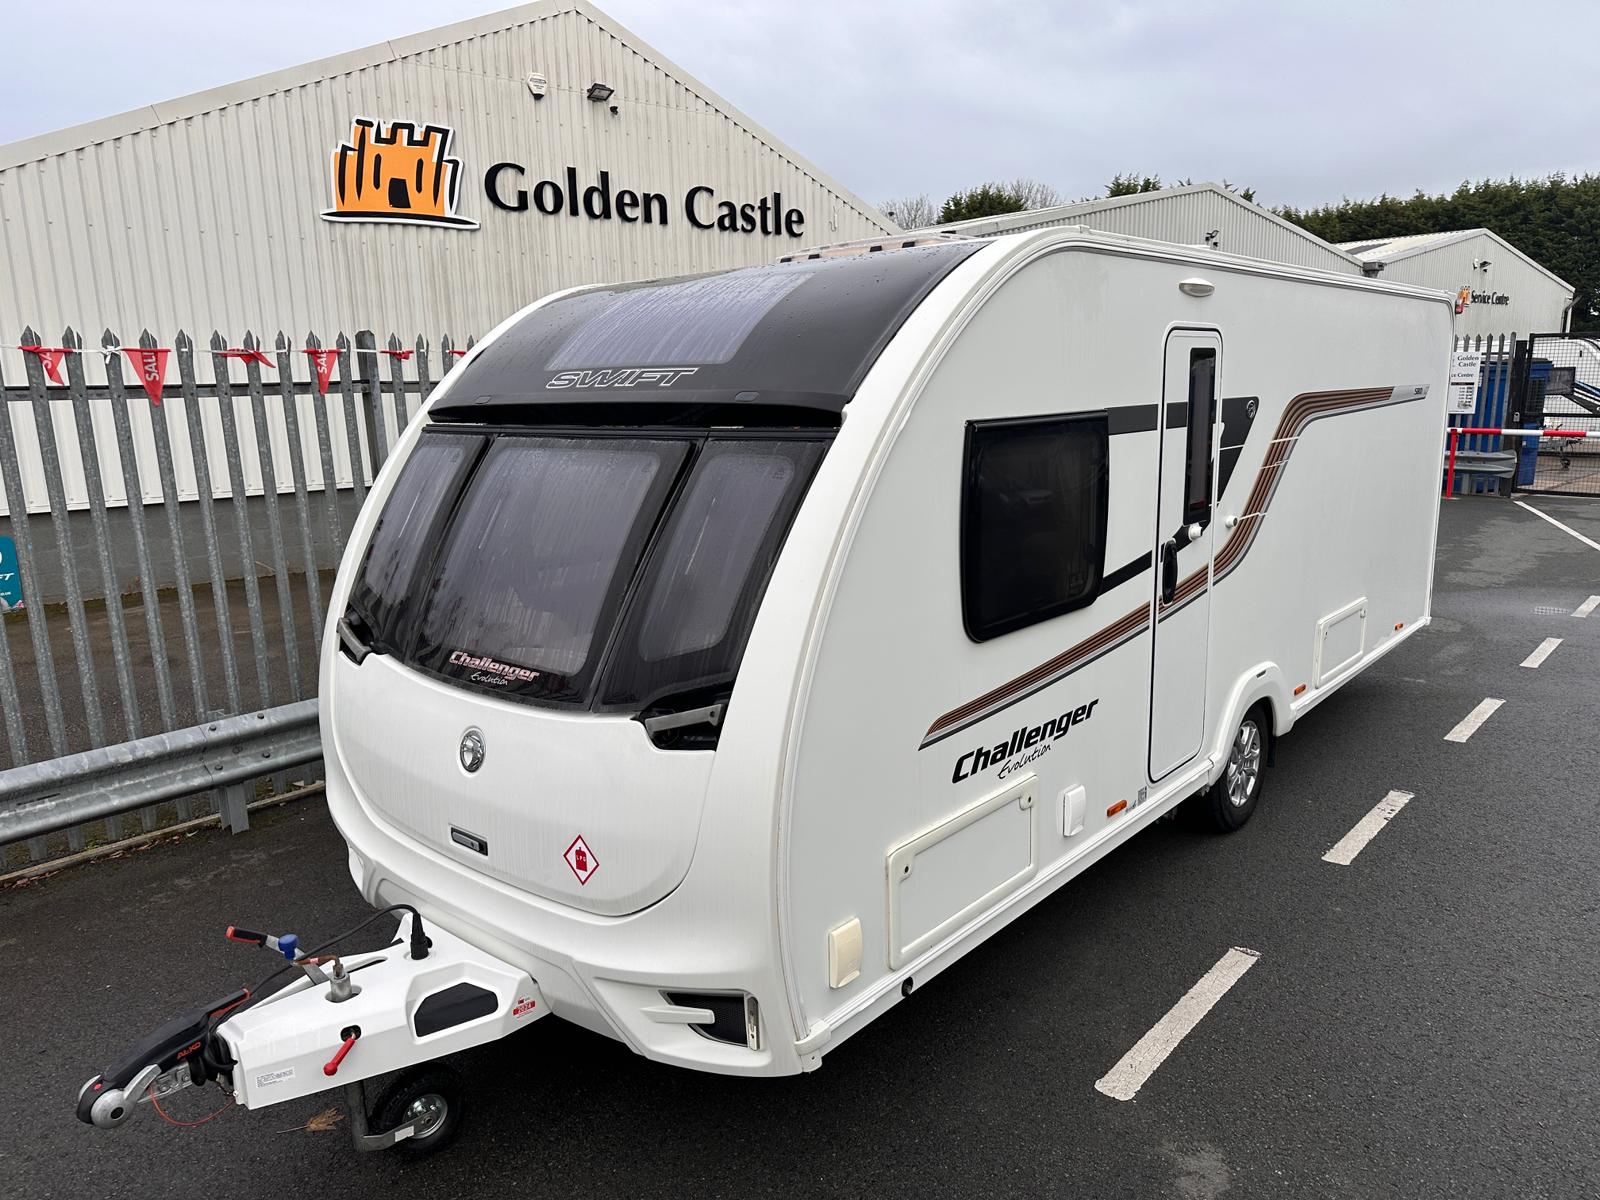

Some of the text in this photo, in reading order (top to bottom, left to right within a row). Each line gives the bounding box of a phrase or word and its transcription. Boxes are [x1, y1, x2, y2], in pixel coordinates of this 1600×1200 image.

[484, 162, 806, 238] Golden Castle
[1471, 290, 1491, 304] Service
[545, 367, 701, 389] SWIFT
[449, 651, 540, 681] Challenger
[470, 671, 508, 686] Evolution
[952, 698, 1099, 784] Challenger
[997, 744, 1052, 779] Evolution
